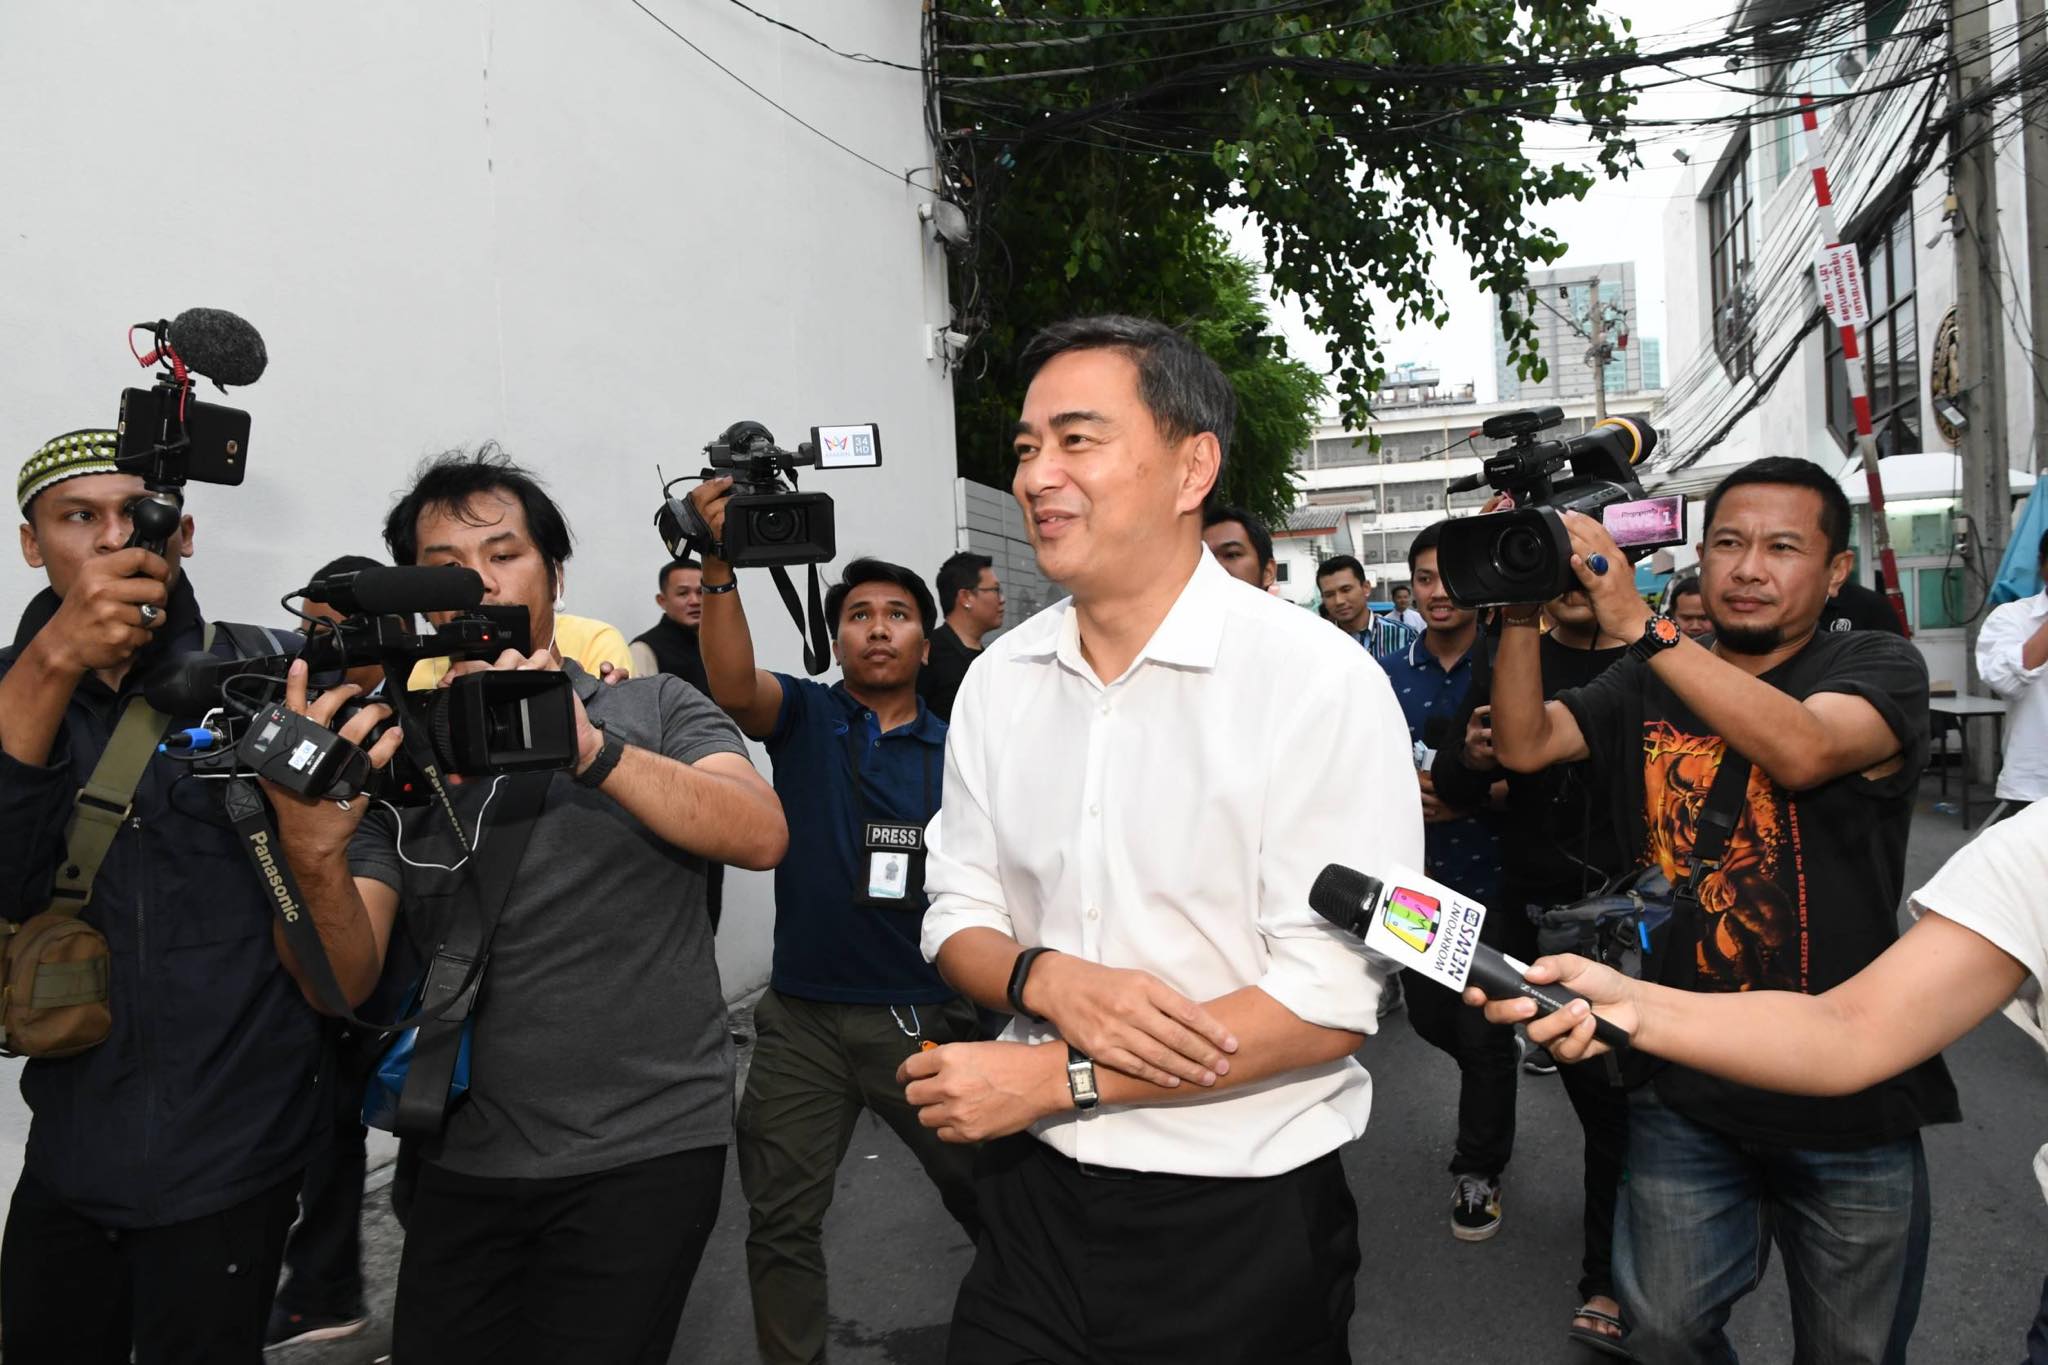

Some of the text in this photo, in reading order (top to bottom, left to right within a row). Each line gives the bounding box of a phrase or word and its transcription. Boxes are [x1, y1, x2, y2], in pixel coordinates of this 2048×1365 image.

[871, 827, 917, 846] PRESS
[249, 830, 300, 923] Panasonic
[1434, 900, 1463, 972] WORKPOINT
[1448, 925, 1476, 983] NEWS
